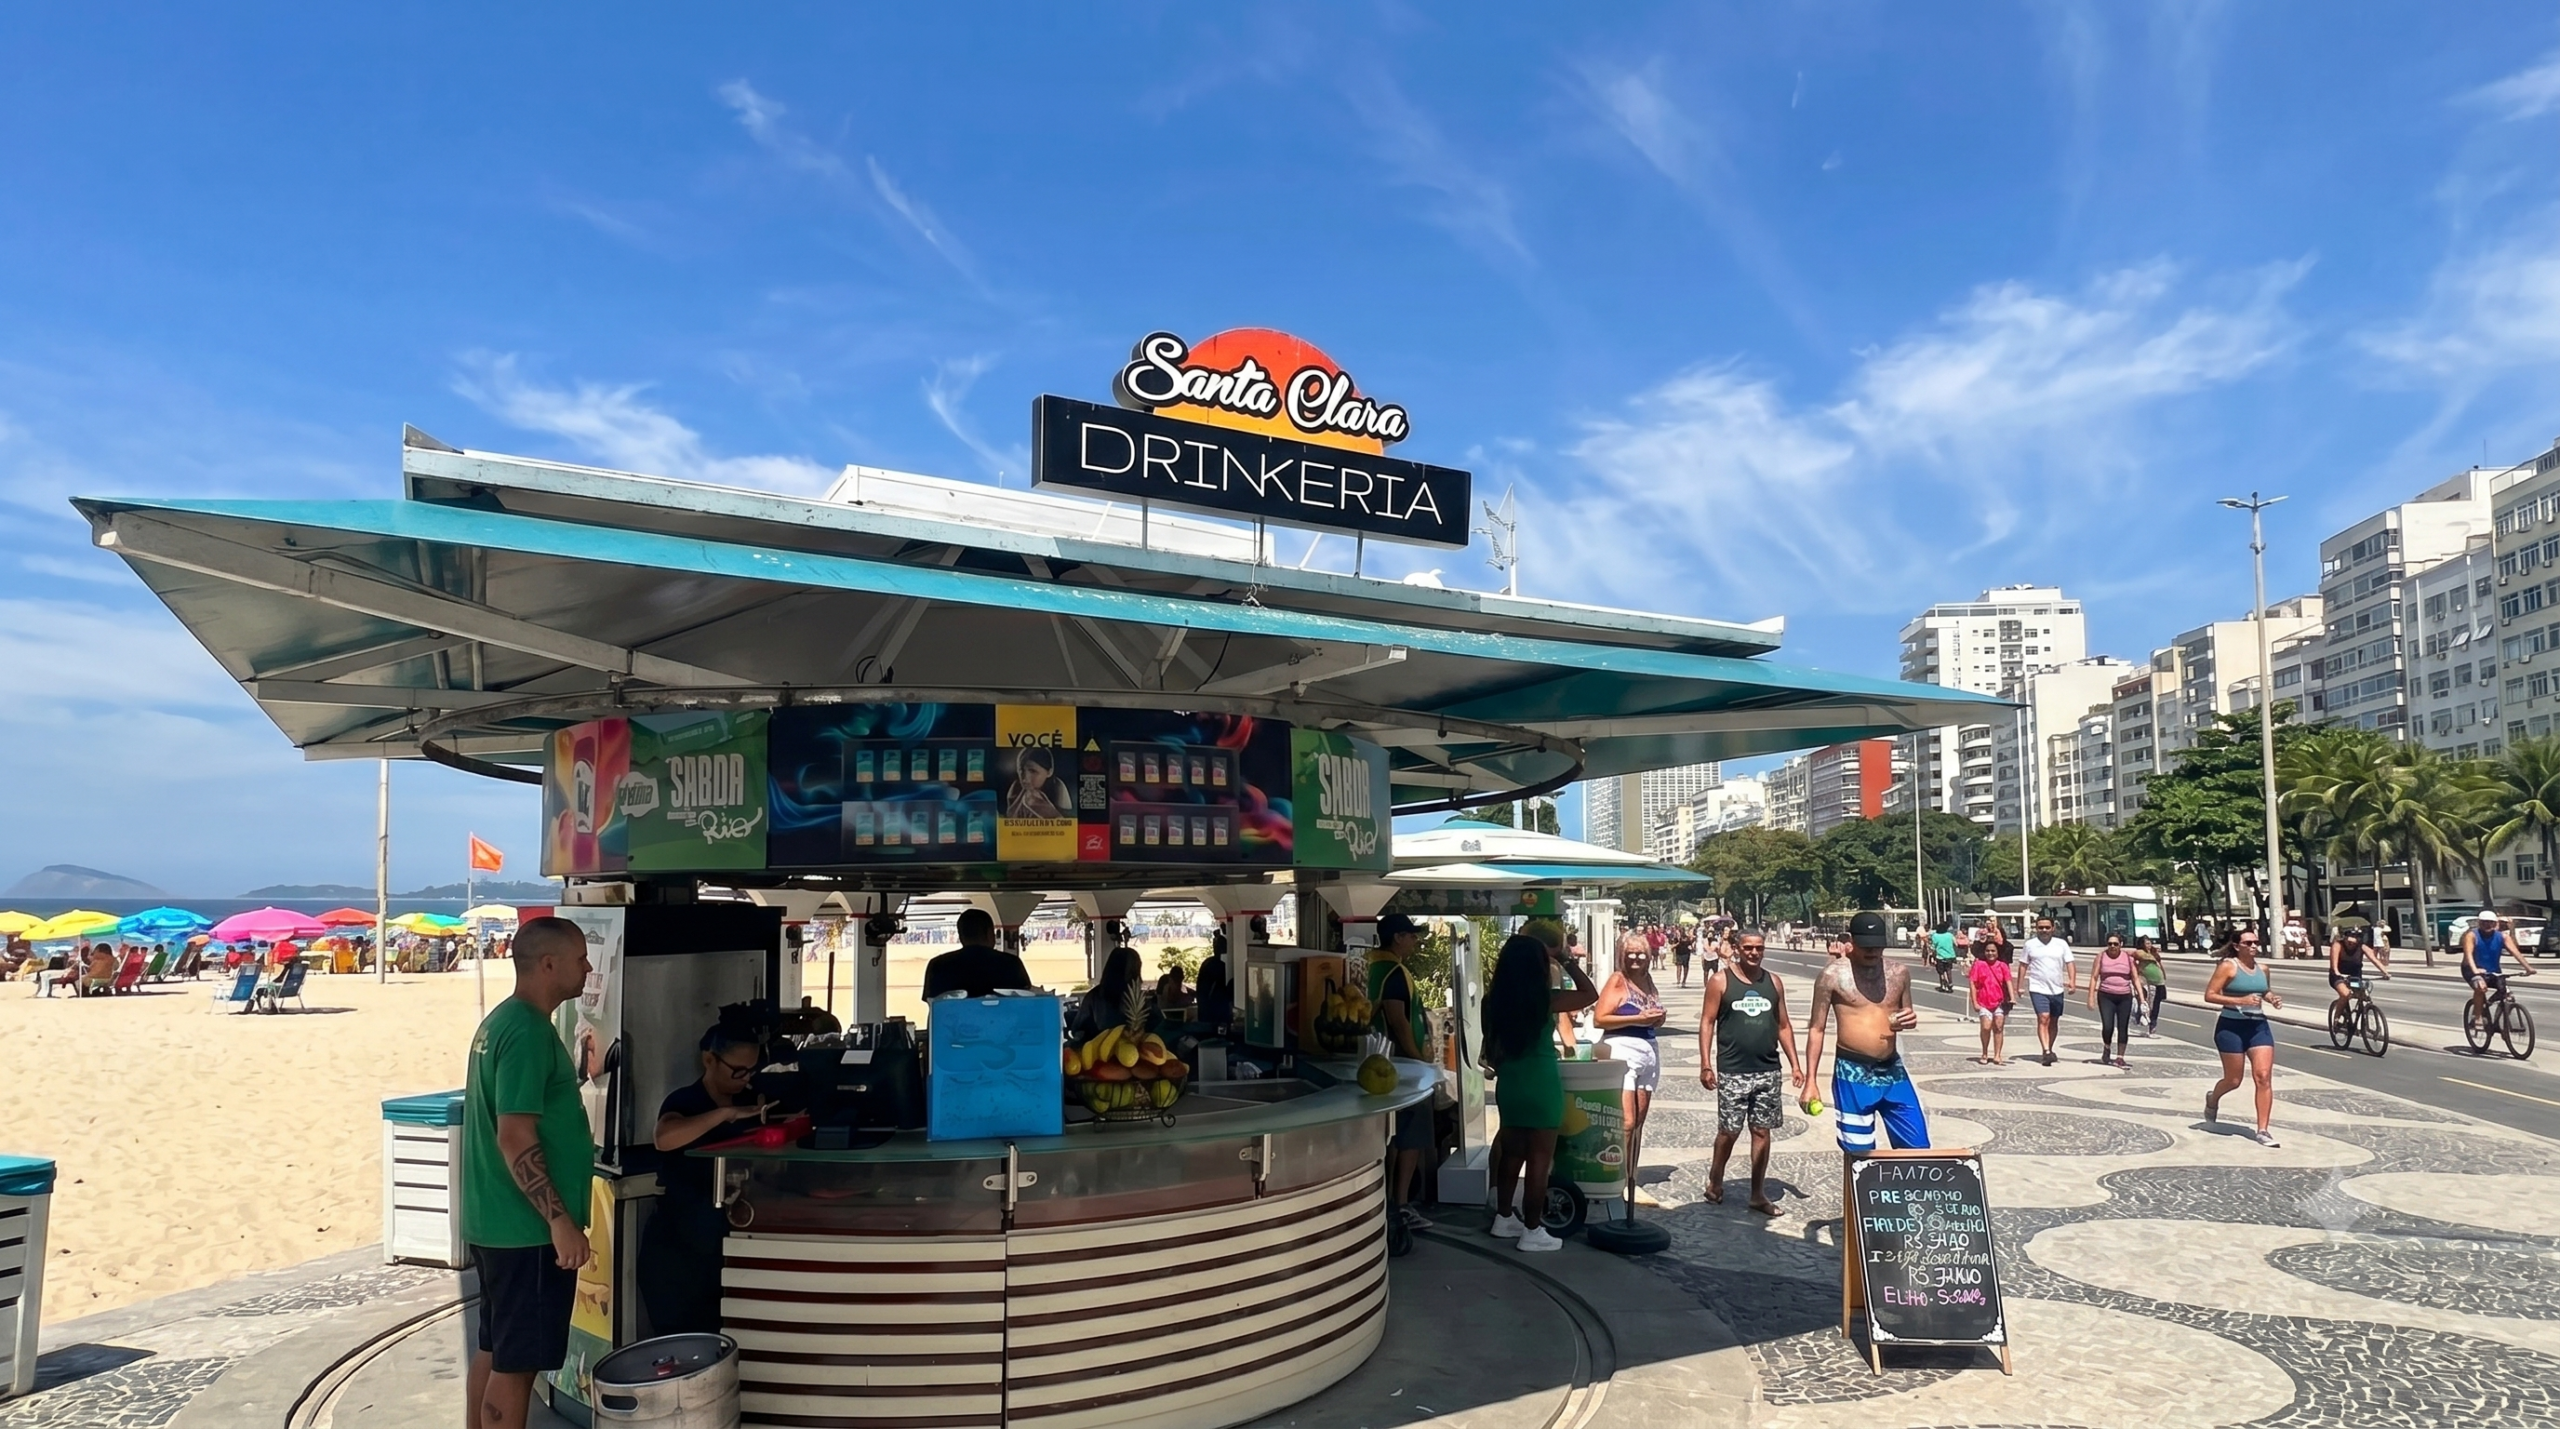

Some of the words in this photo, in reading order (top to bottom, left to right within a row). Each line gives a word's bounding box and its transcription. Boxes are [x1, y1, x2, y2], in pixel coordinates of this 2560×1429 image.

[1127, 336, 1277, 413] Santa
[1287, 370, 1406, 438] Clara
[1081, 422, 1443, 526] DRINKERIA
